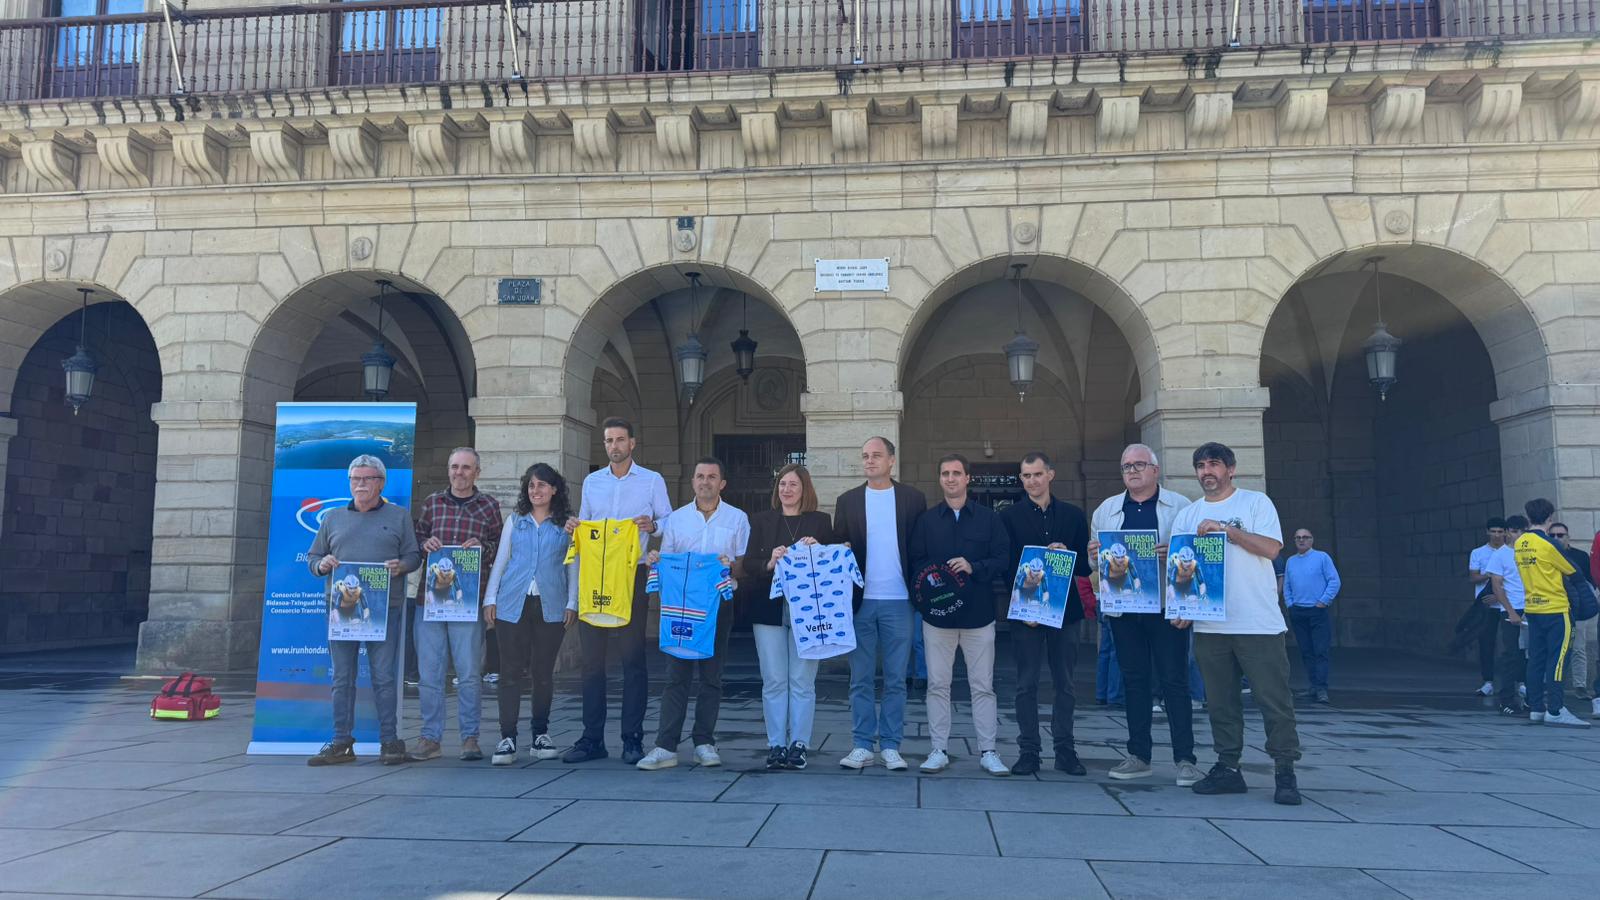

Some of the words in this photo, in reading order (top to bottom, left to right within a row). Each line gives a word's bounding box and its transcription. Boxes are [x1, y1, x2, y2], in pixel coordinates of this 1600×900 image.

[502, 294, 515, 302] SAN
[1124, 535, 1155, 543] BIDASOA
[1193, 537, 1223, 546] BIDASOA
[1128, 542, 1155, 550] ITZULIA
[1196, 545, 1223, 554] ITZULIA
[1044, 551, 1073, 562] BIDASOA
[1204, 553, 1223, 561] 2026
[1046, 559, 1072, 570] ITZULIA
[359, 567, 388, 575] BIDASOA
[1052, 566, 1071, 576] 2026
[361, 574, 388, 582] ITZULIA
[369, 581, 387, 589] 2026
[266, 599, 317, 607] Bidasoa-Txingudi
[805, 621, 833, 632] Vertiz
